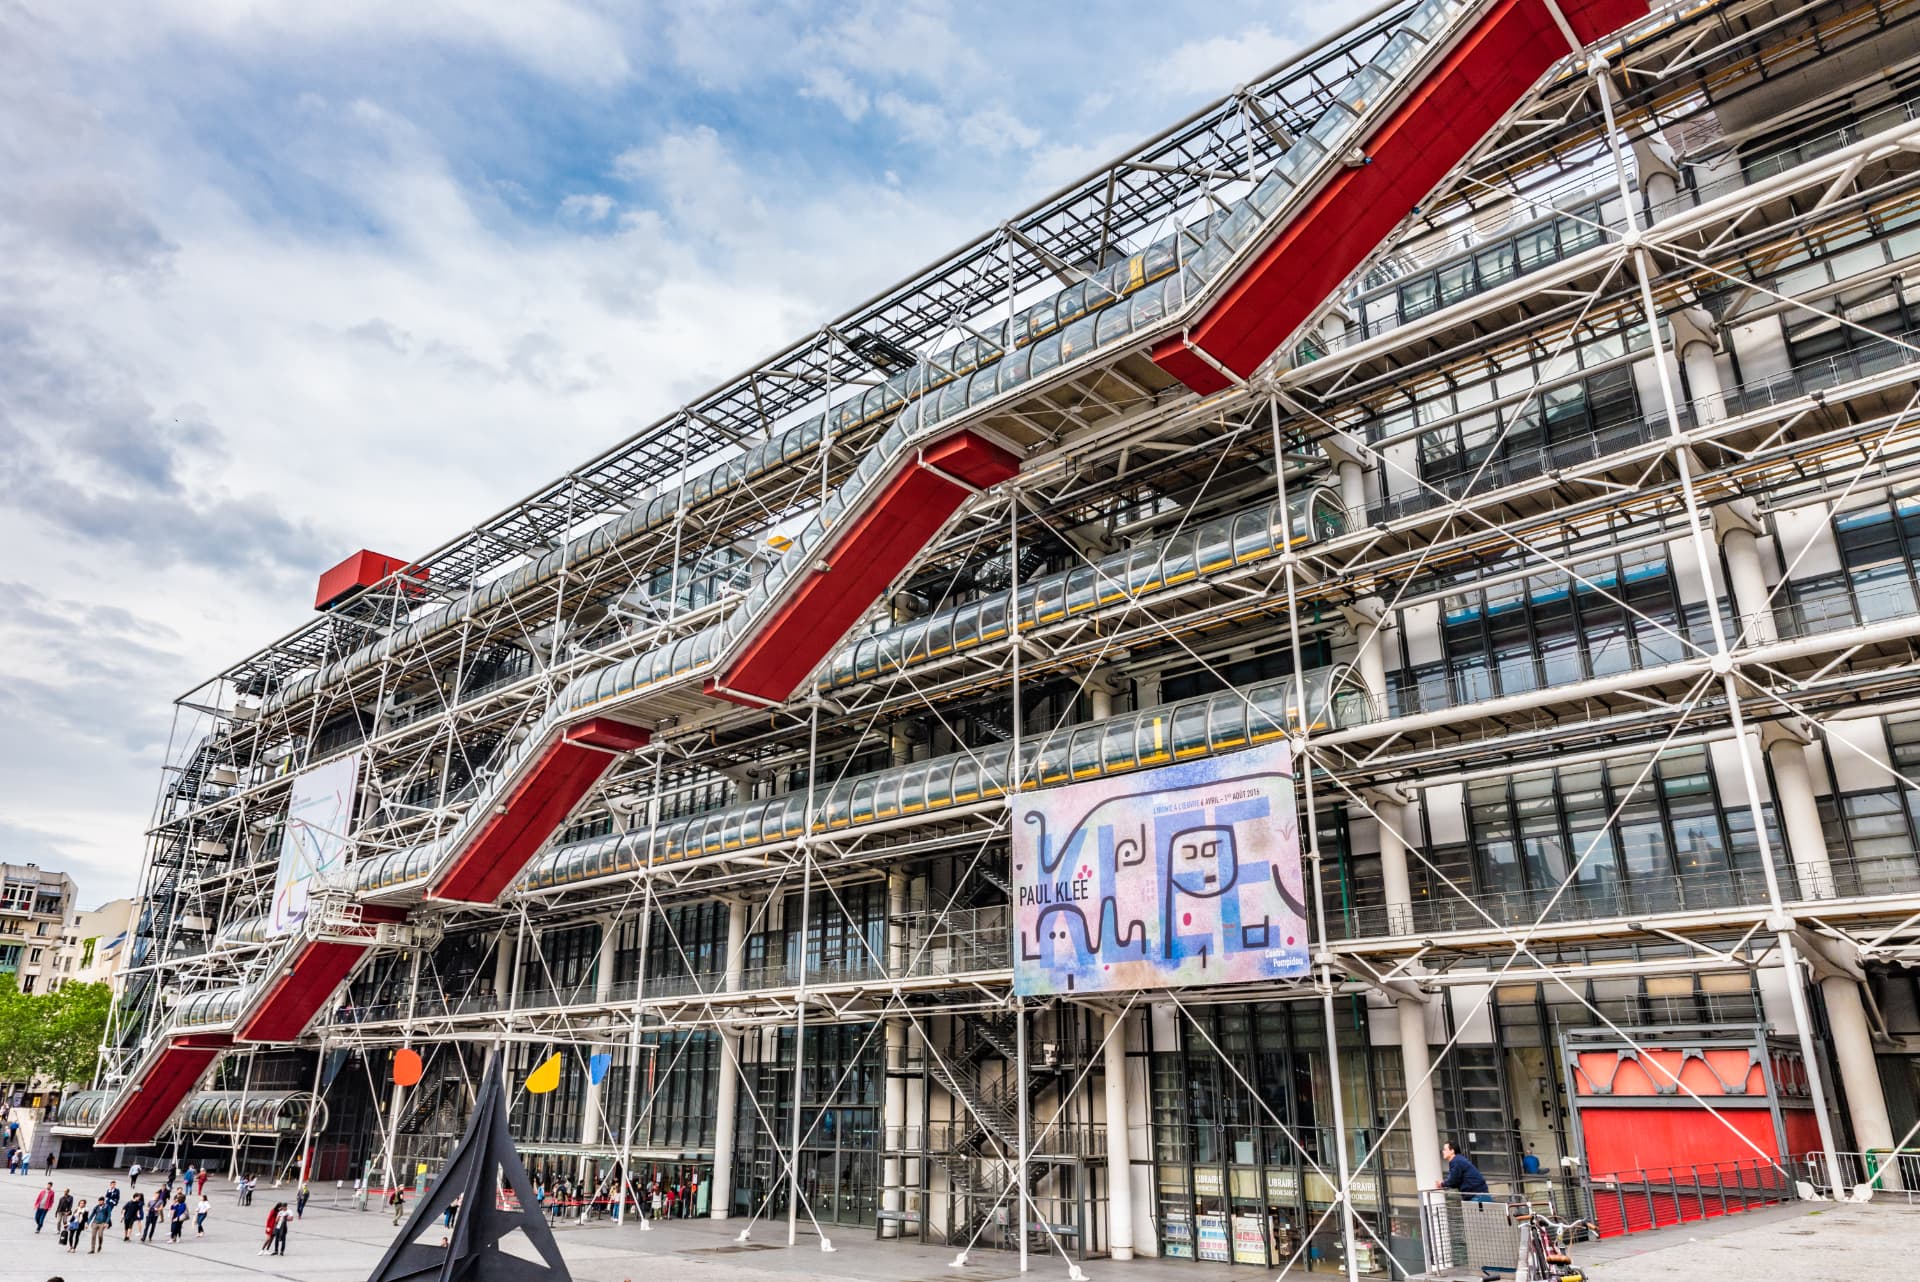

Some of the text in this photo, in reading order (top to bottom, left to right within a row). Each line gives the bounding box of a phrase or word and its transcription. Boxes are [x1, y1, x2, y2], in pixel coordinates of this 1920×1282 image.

[1205, 796, 1219, 805] AVRIL
[1019, 879, 1089, 906] PAUL KLEE
[1273, 956, 1303, 968] Pompidou
